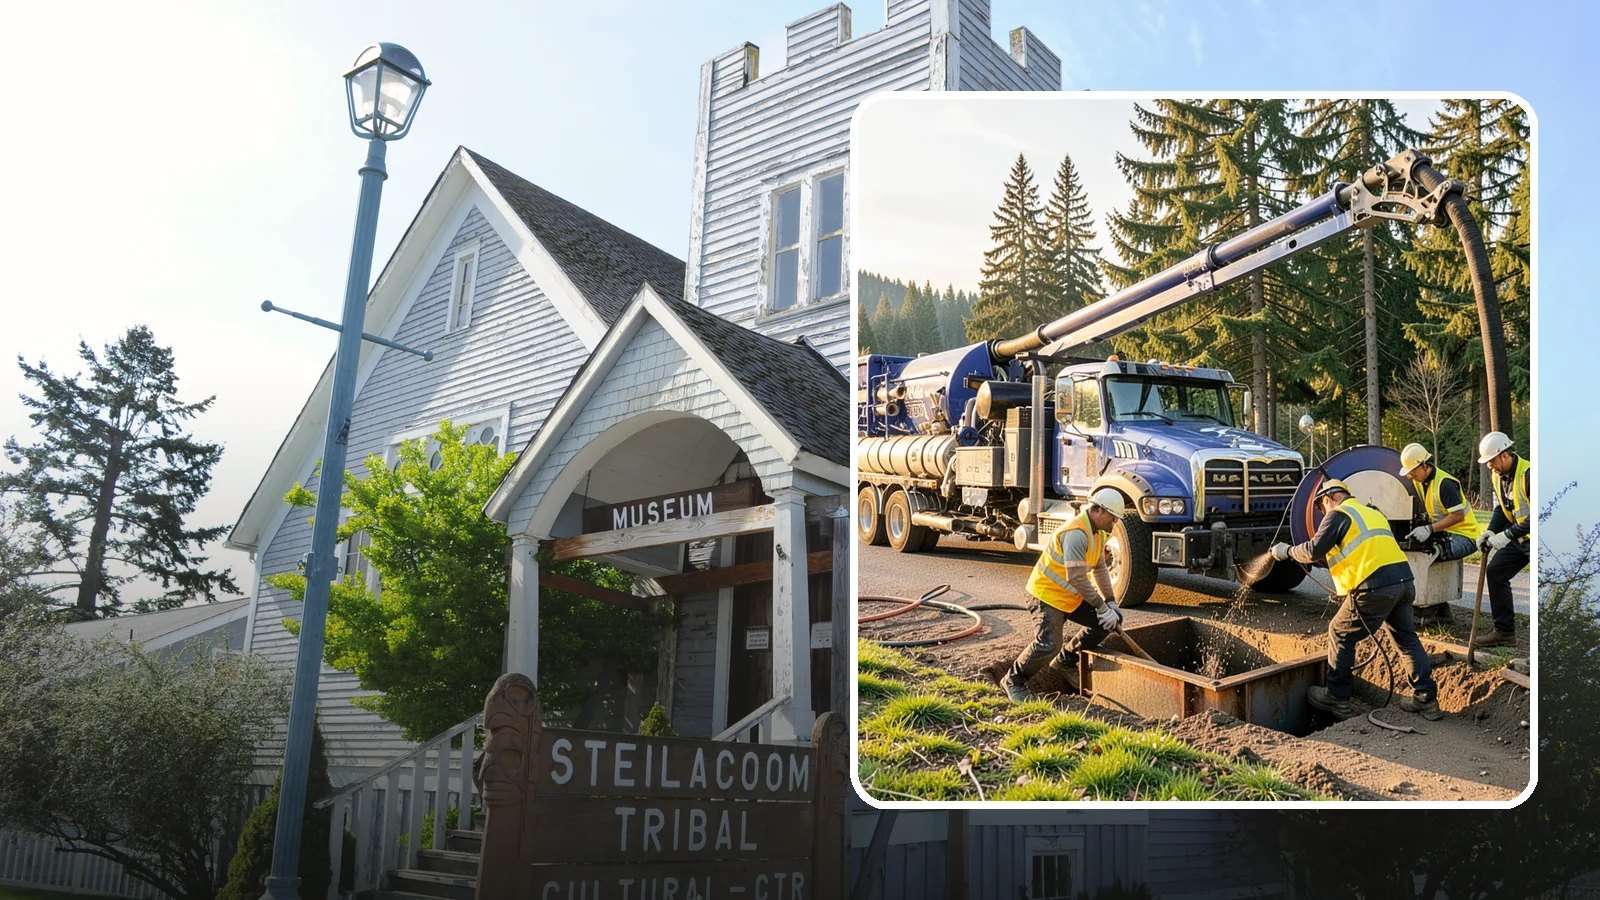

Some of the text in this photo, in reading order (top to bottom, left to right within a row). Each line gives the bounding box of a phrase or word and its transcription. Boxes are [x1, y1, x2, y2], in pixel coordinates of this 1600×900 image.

[612, 491, 714, 531] MUSEUM
[550, 738, 810, 793] STEILACOOM
[614, 806, 758, 852] TRIBAL
